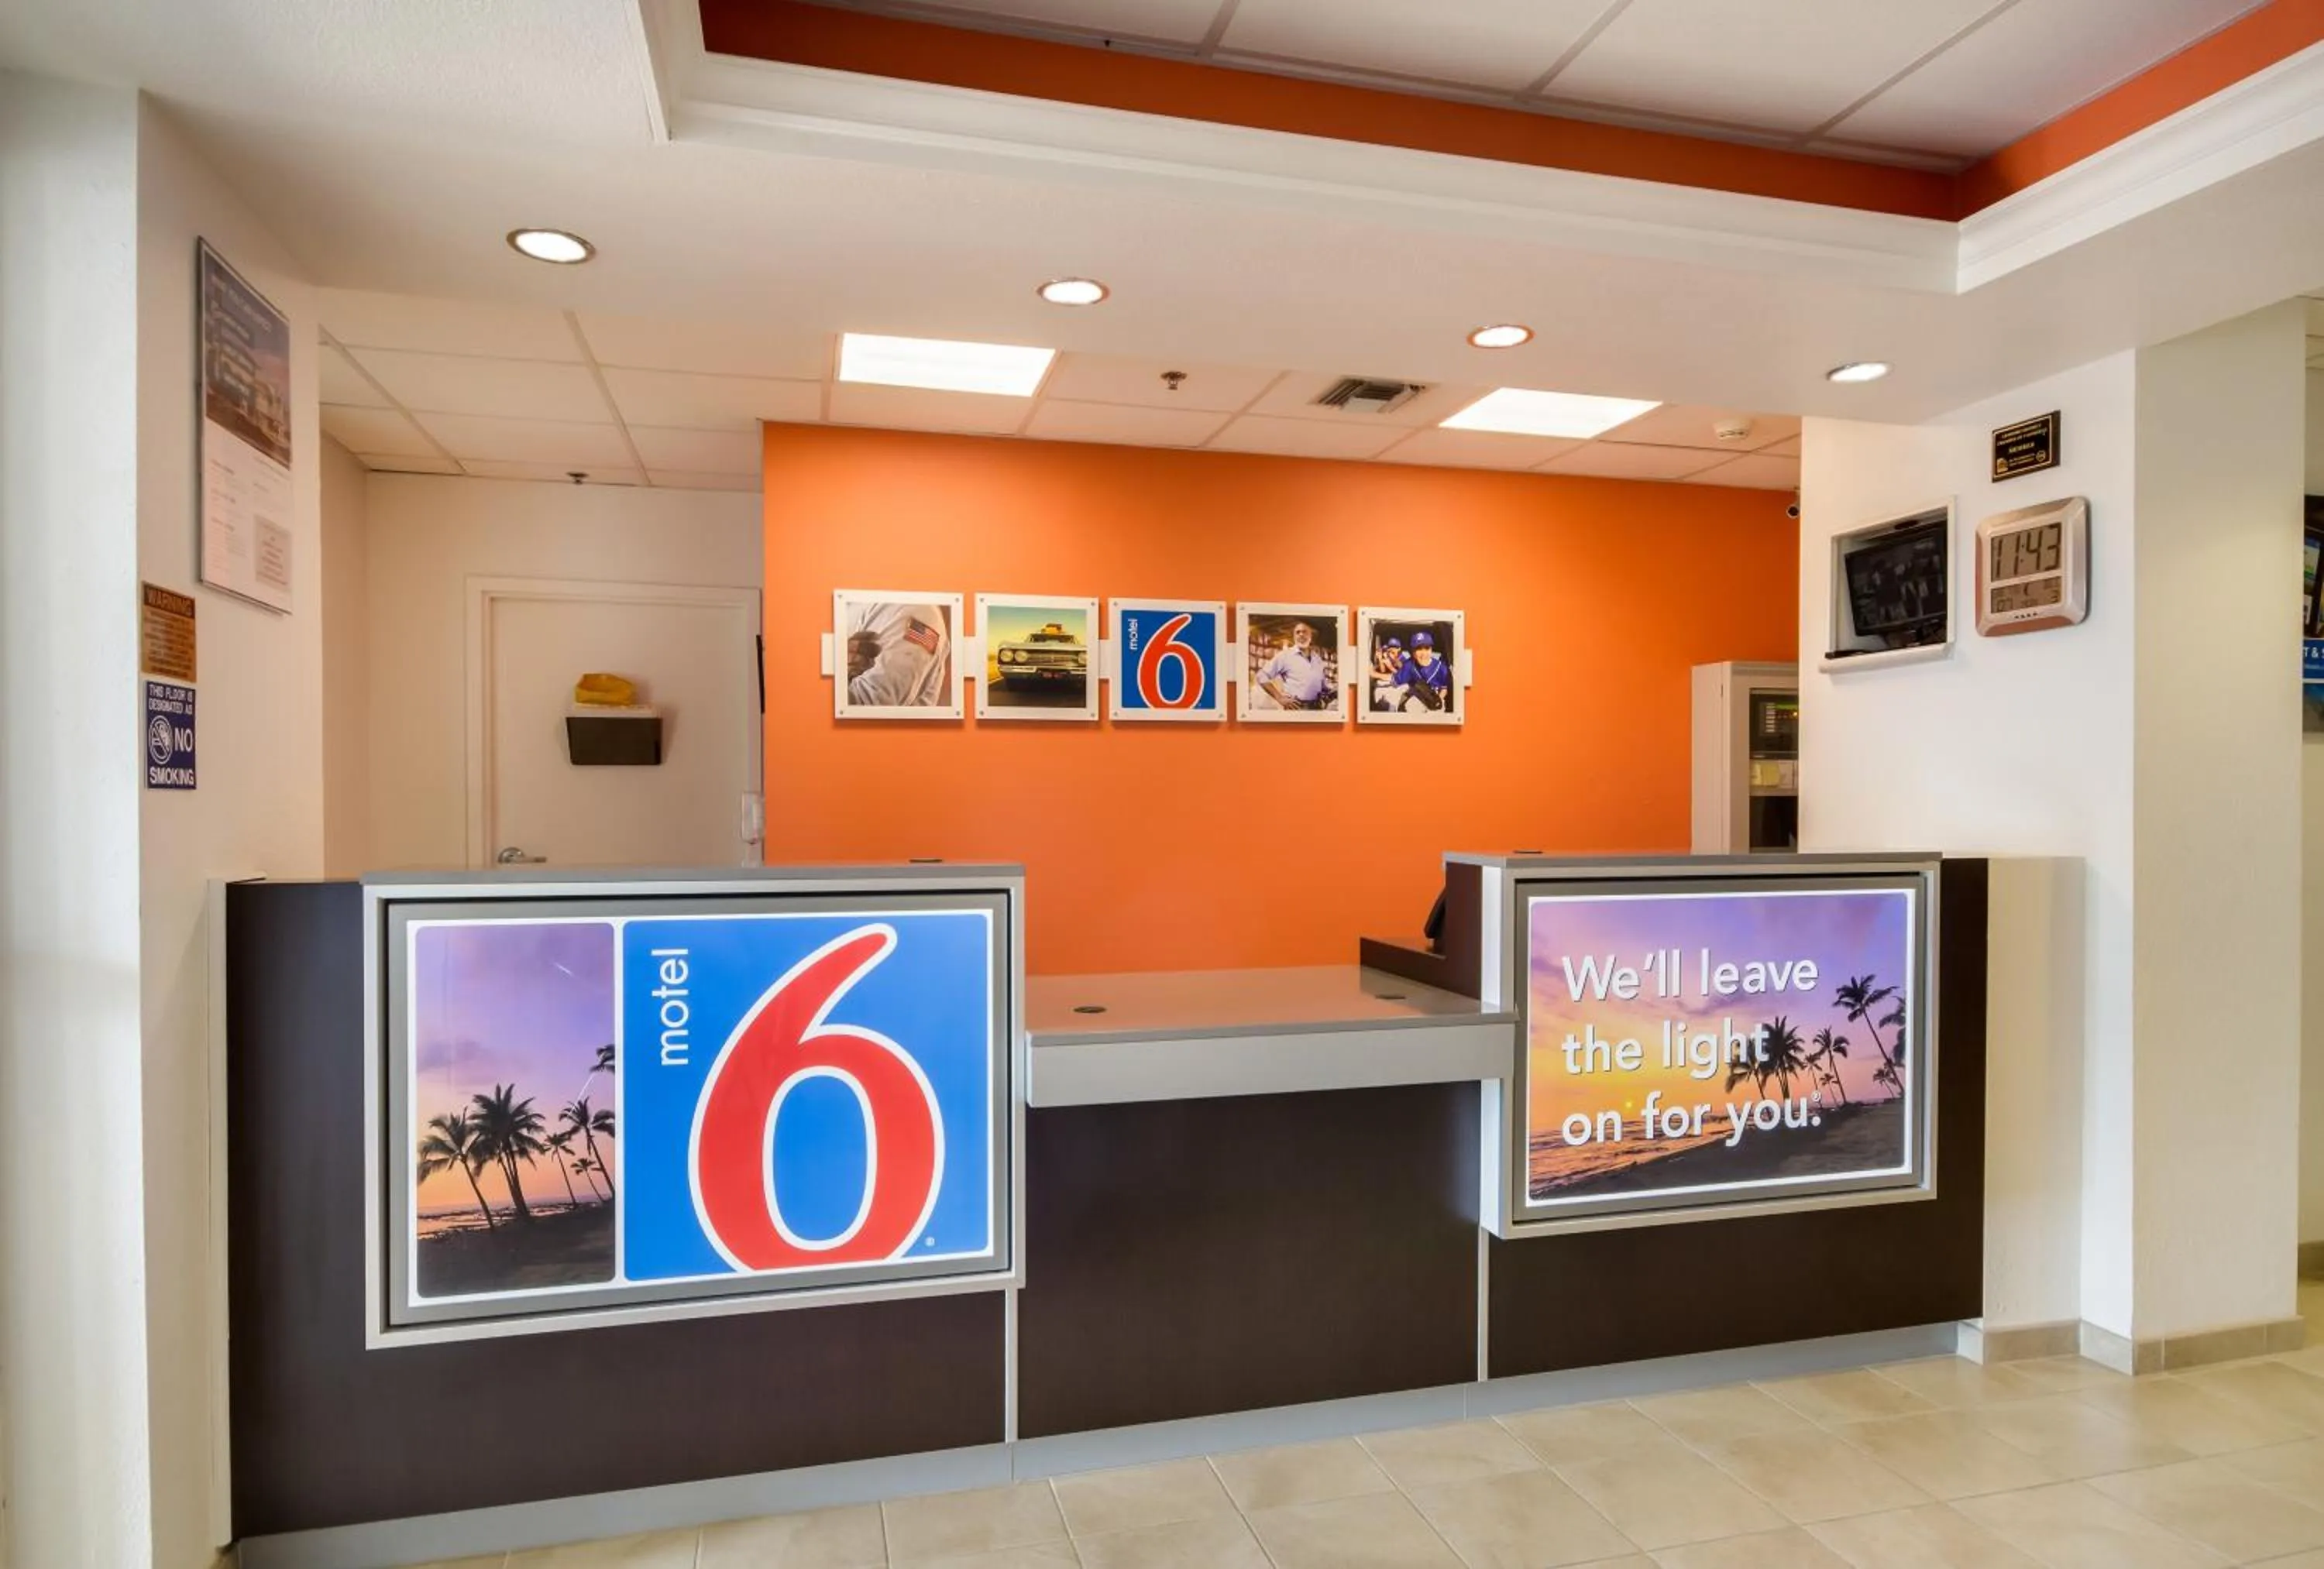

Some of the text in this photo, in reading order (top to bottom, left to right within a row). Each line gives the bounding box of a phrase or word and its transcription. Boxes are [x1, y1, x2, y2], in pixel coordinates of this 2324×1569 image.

[1996, 522, 2062, 579] 11:43
[147, 587, 193, 617] WARNING
[1128, 613, 1205, 709] motel 6
[148, 684, 165, 698] THIS
[148, 697, 184, 713] DESIGNATED
[174, 726, 194, 753] NO
[150, 766, 194, 785] SMOKING
[1561, 947, 1819, 1002] We'll leave
[1561, 1017, 1771, 1079] the light
[651, 922, 945, 1275] motel 6
[1561, 1090, 1821, 1148] on for you.
